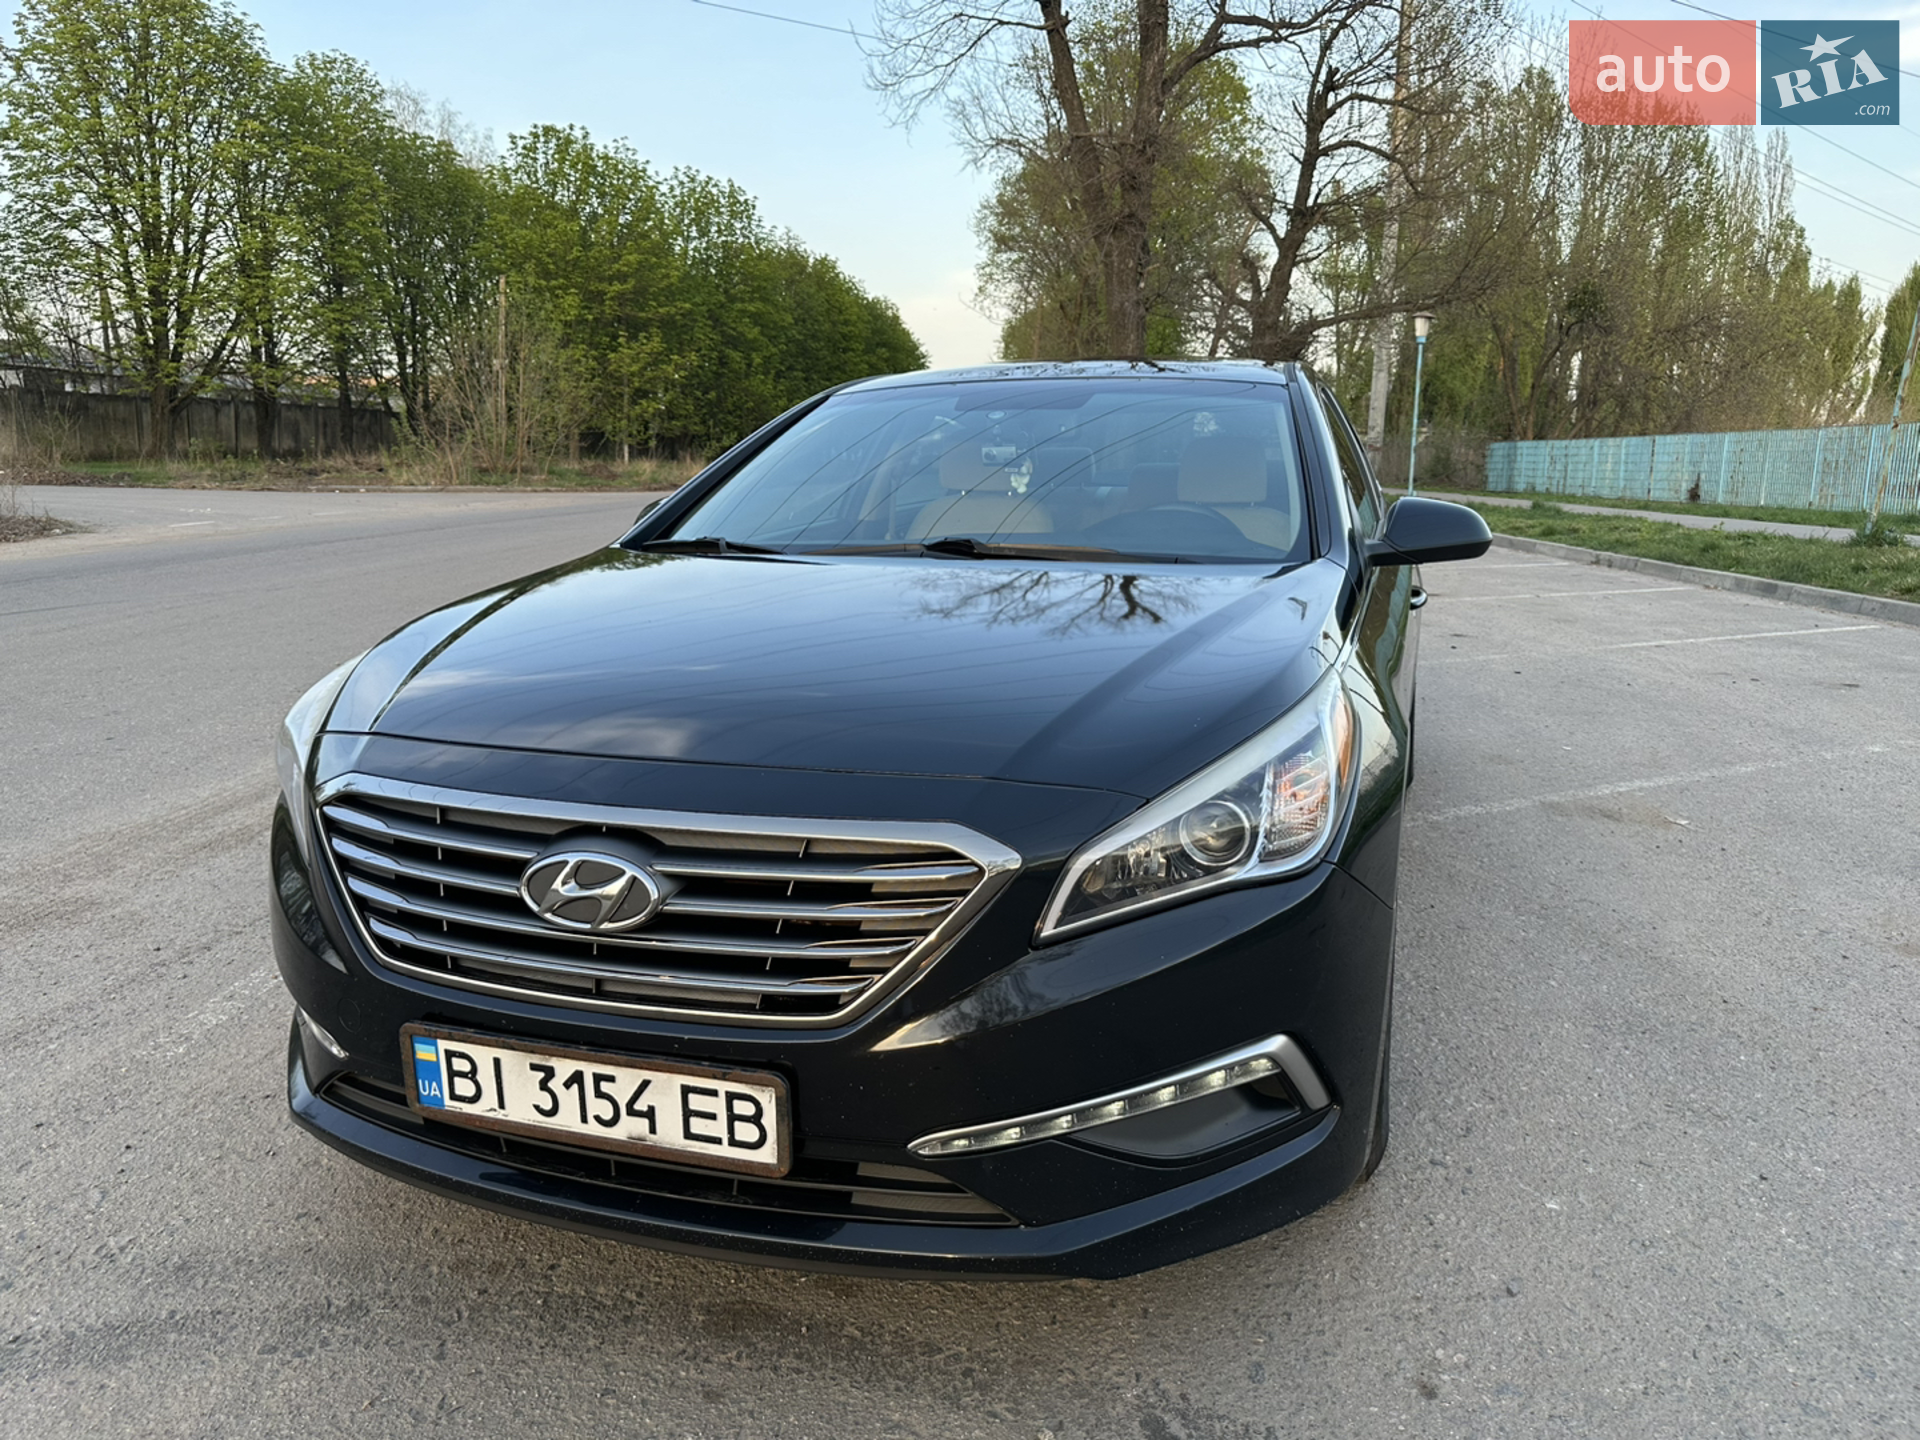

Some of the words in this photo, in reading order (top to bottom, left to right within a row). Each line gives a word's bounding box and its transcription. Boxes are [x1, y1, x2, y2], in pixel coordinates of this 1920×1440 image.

[418, 1078, 441, 1098] UA
[444, 1048, 506, 1110] BI
[529, 1063, 657, 1135] 3154
[680, 1083, 768, 1150] EB
